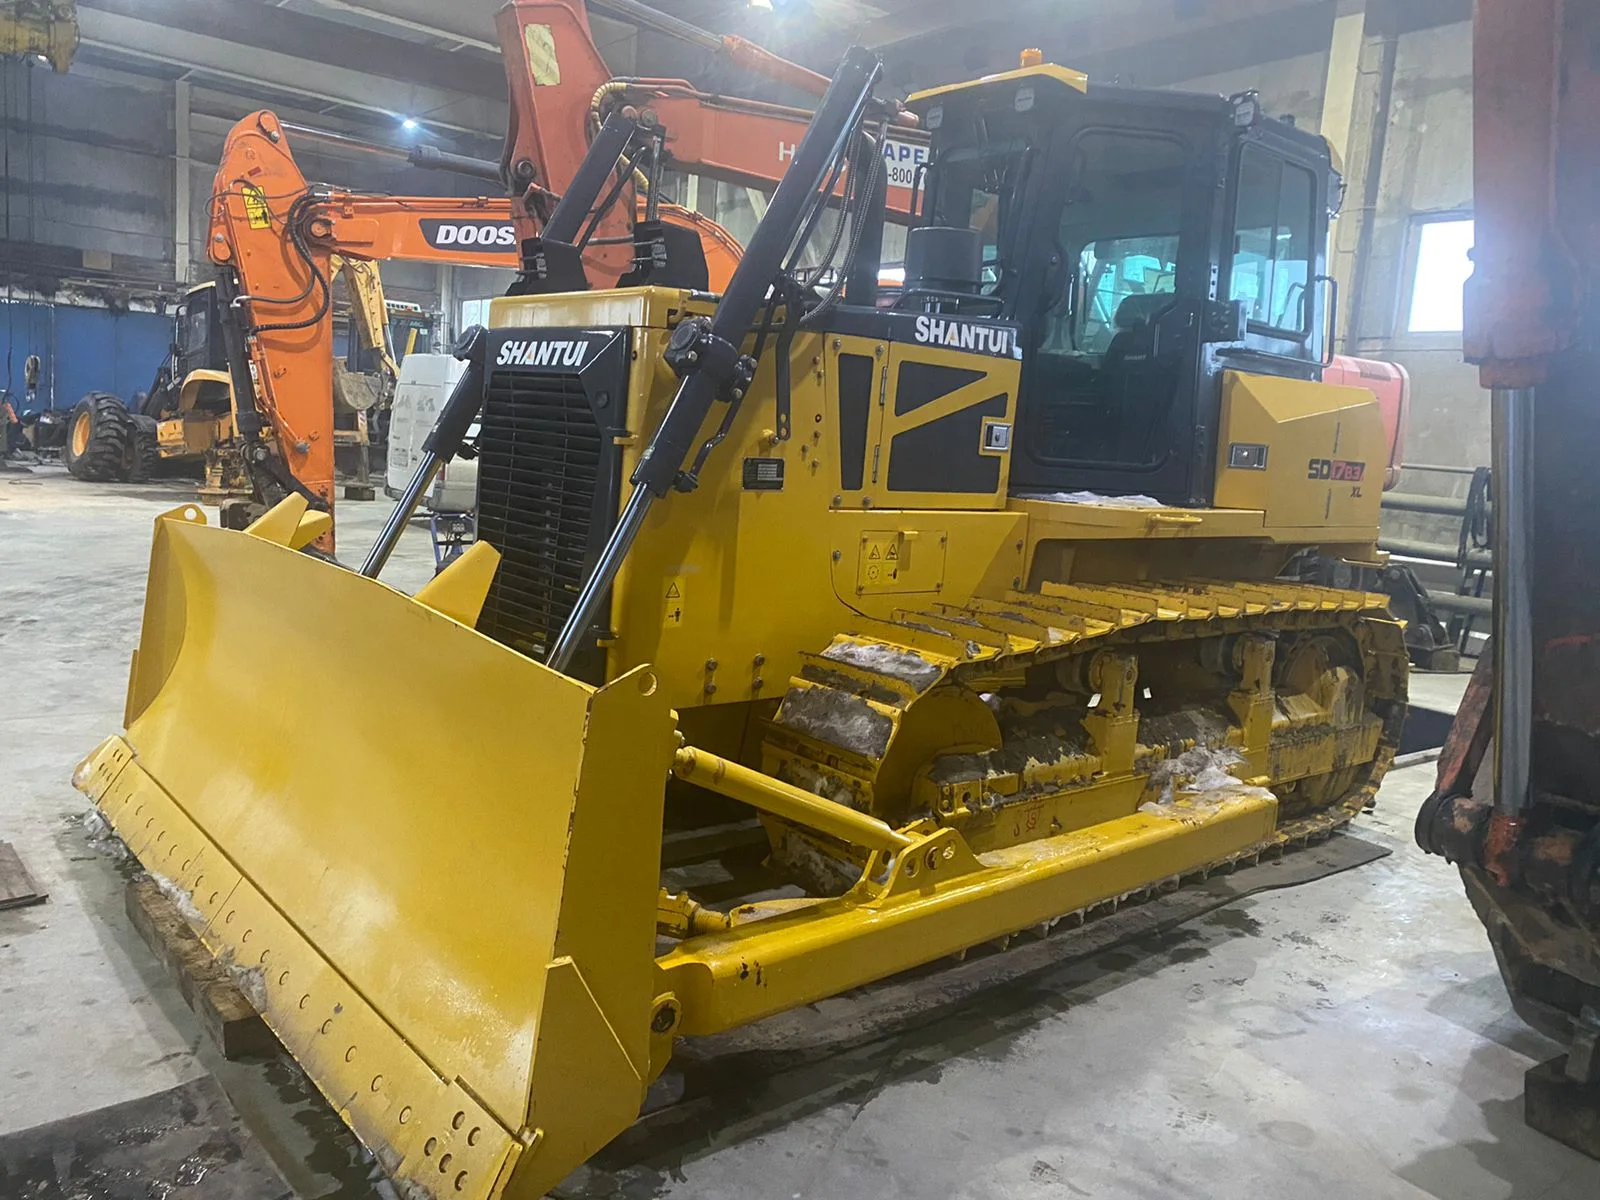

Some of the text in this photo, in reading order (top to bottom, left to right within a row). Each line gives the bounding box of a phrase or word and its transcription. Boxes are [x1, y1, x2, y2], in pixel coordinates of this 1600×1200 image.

[436, 225, 517, 245] DOOS
[915, 315, 1008, 354] SHANTUI
[496, 340, 589, 367] SHANTUI
